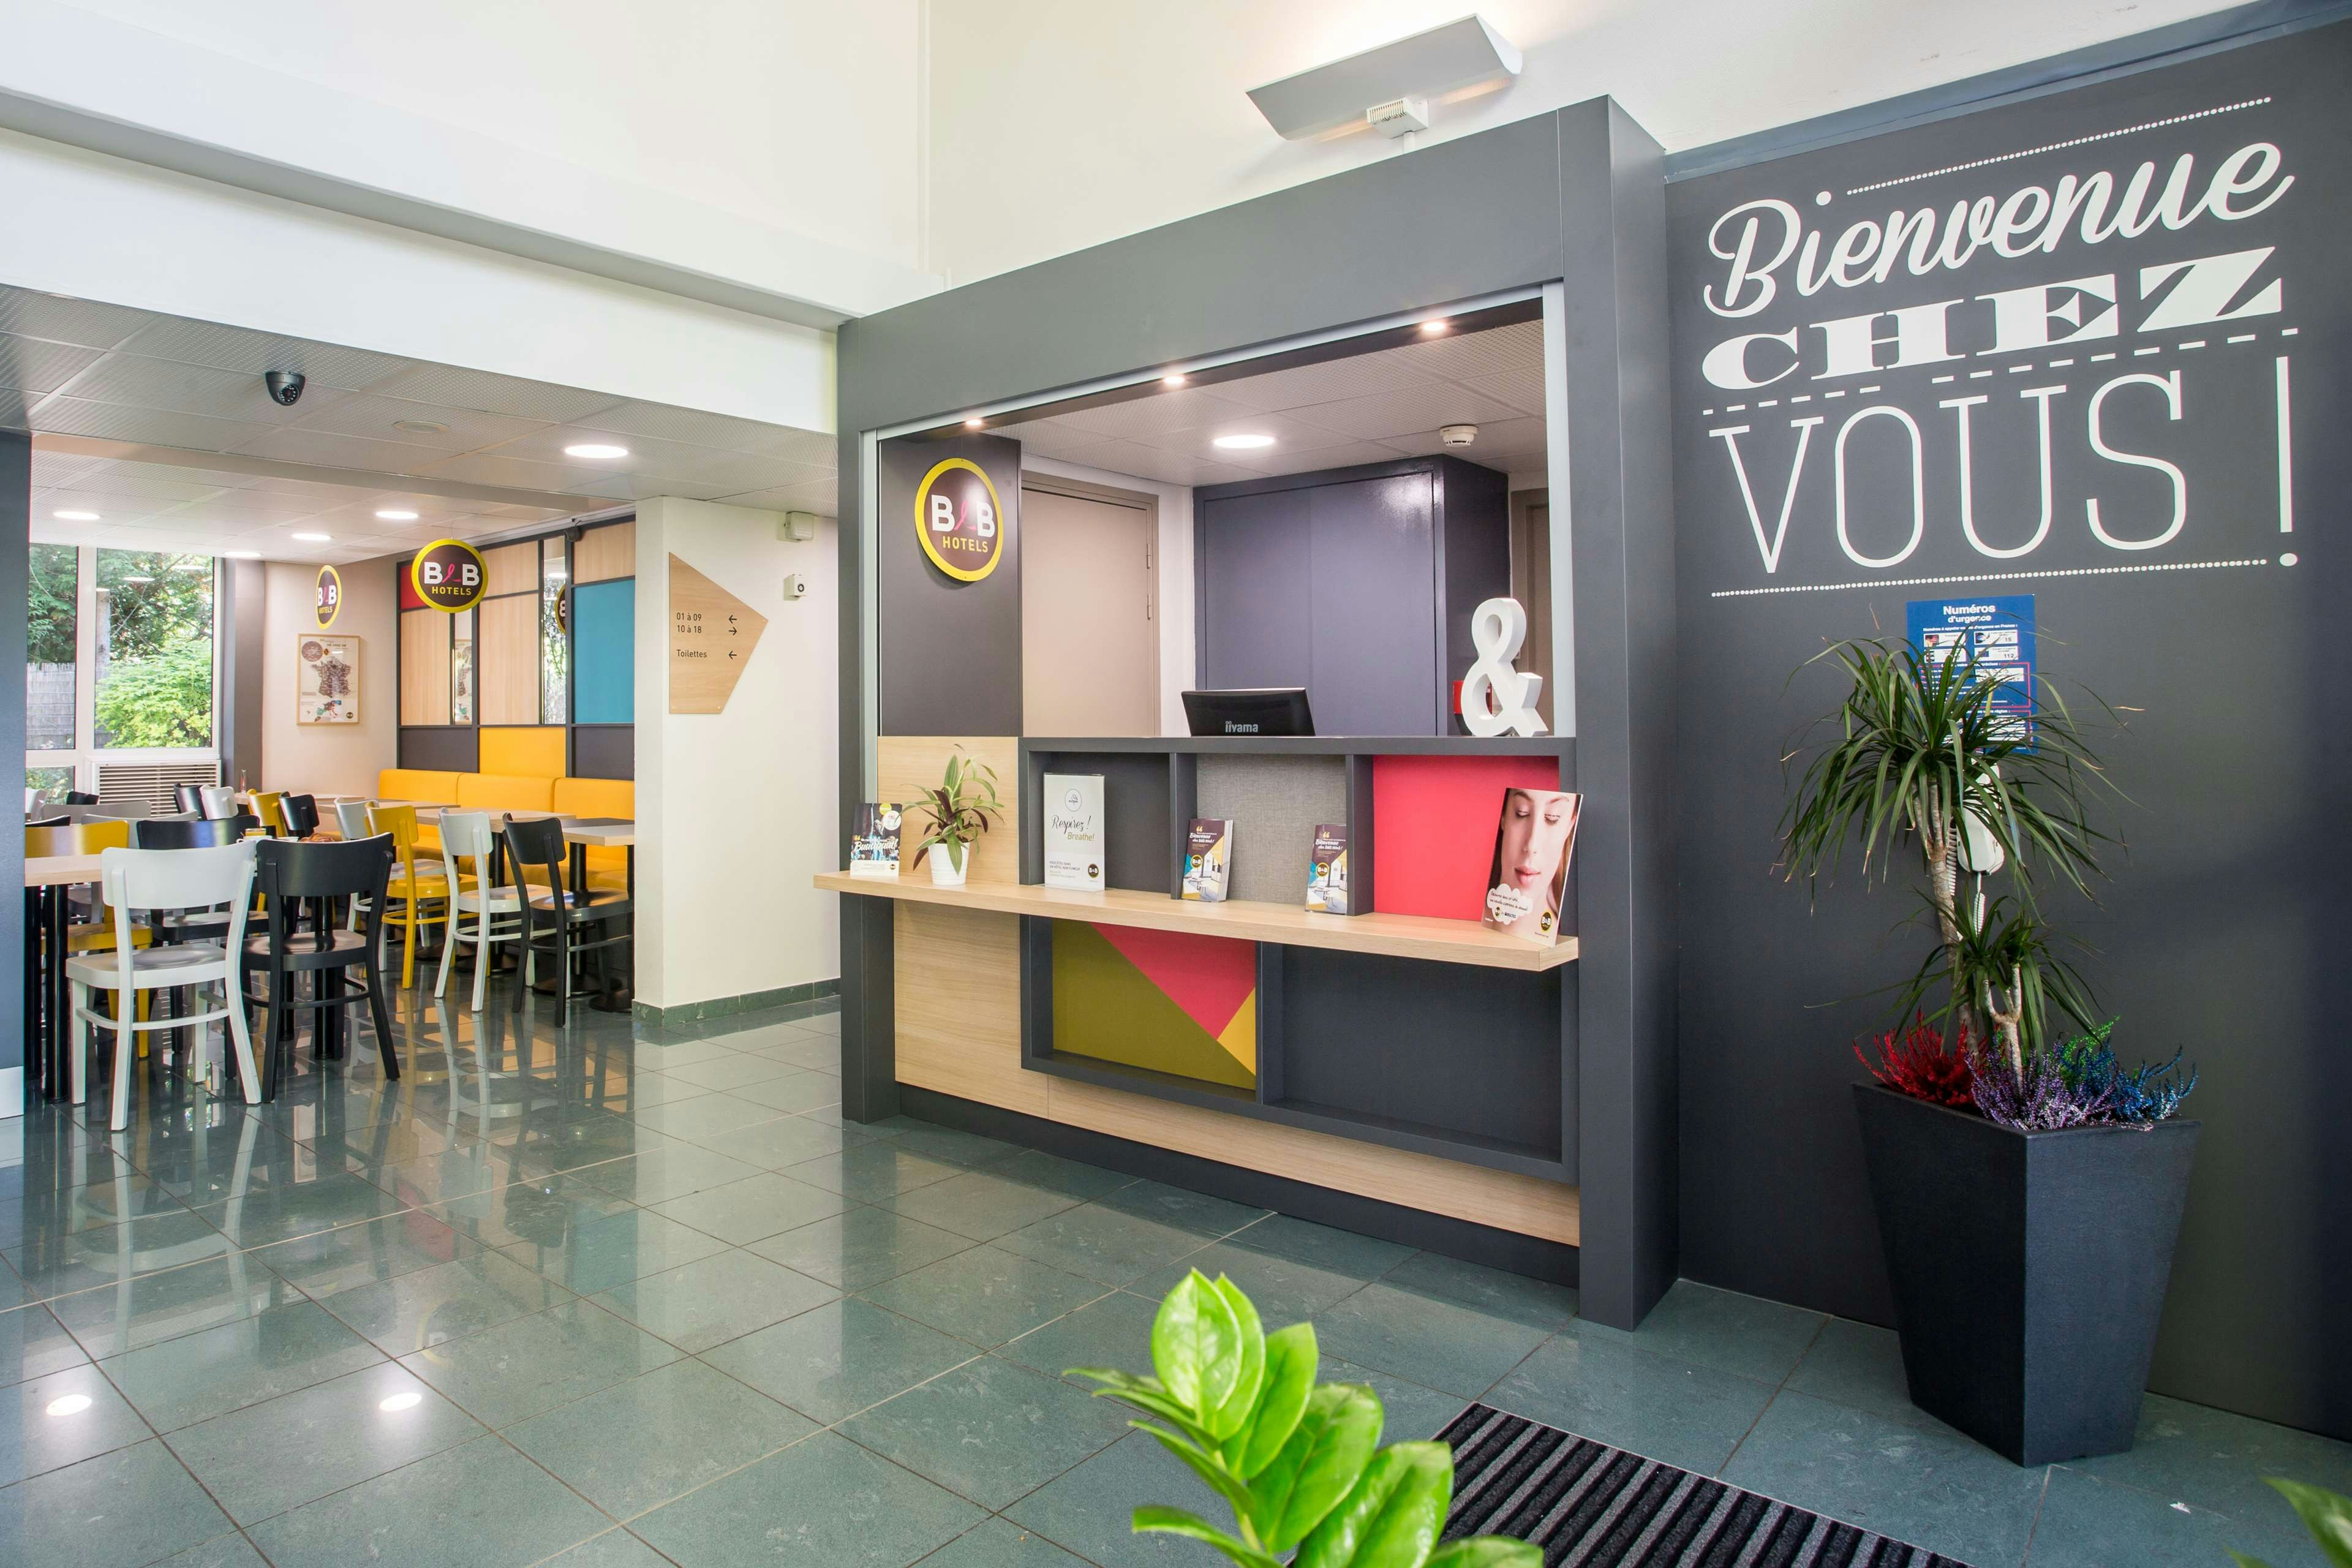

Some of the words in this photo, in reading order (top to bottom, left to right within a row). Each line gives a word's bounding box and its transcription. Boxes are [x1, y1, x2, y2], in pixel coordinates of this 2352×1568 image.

[1703, 142, 2295, 317] Bienvenue
[1702, 246, 2282, 390] CHEZ
[1709, 369, 2187, 574] VOUS
[943, 536, 988, 552] HOTELS
[432, 586, 472, 596] HOTELS
[1943, 604, 1996, 615] Numéros
[676, 649, 707, 658] Toilettes
[1225, 720, 1259, 733] iiyama
[1067, 832, 1095, 842] Breathe!
